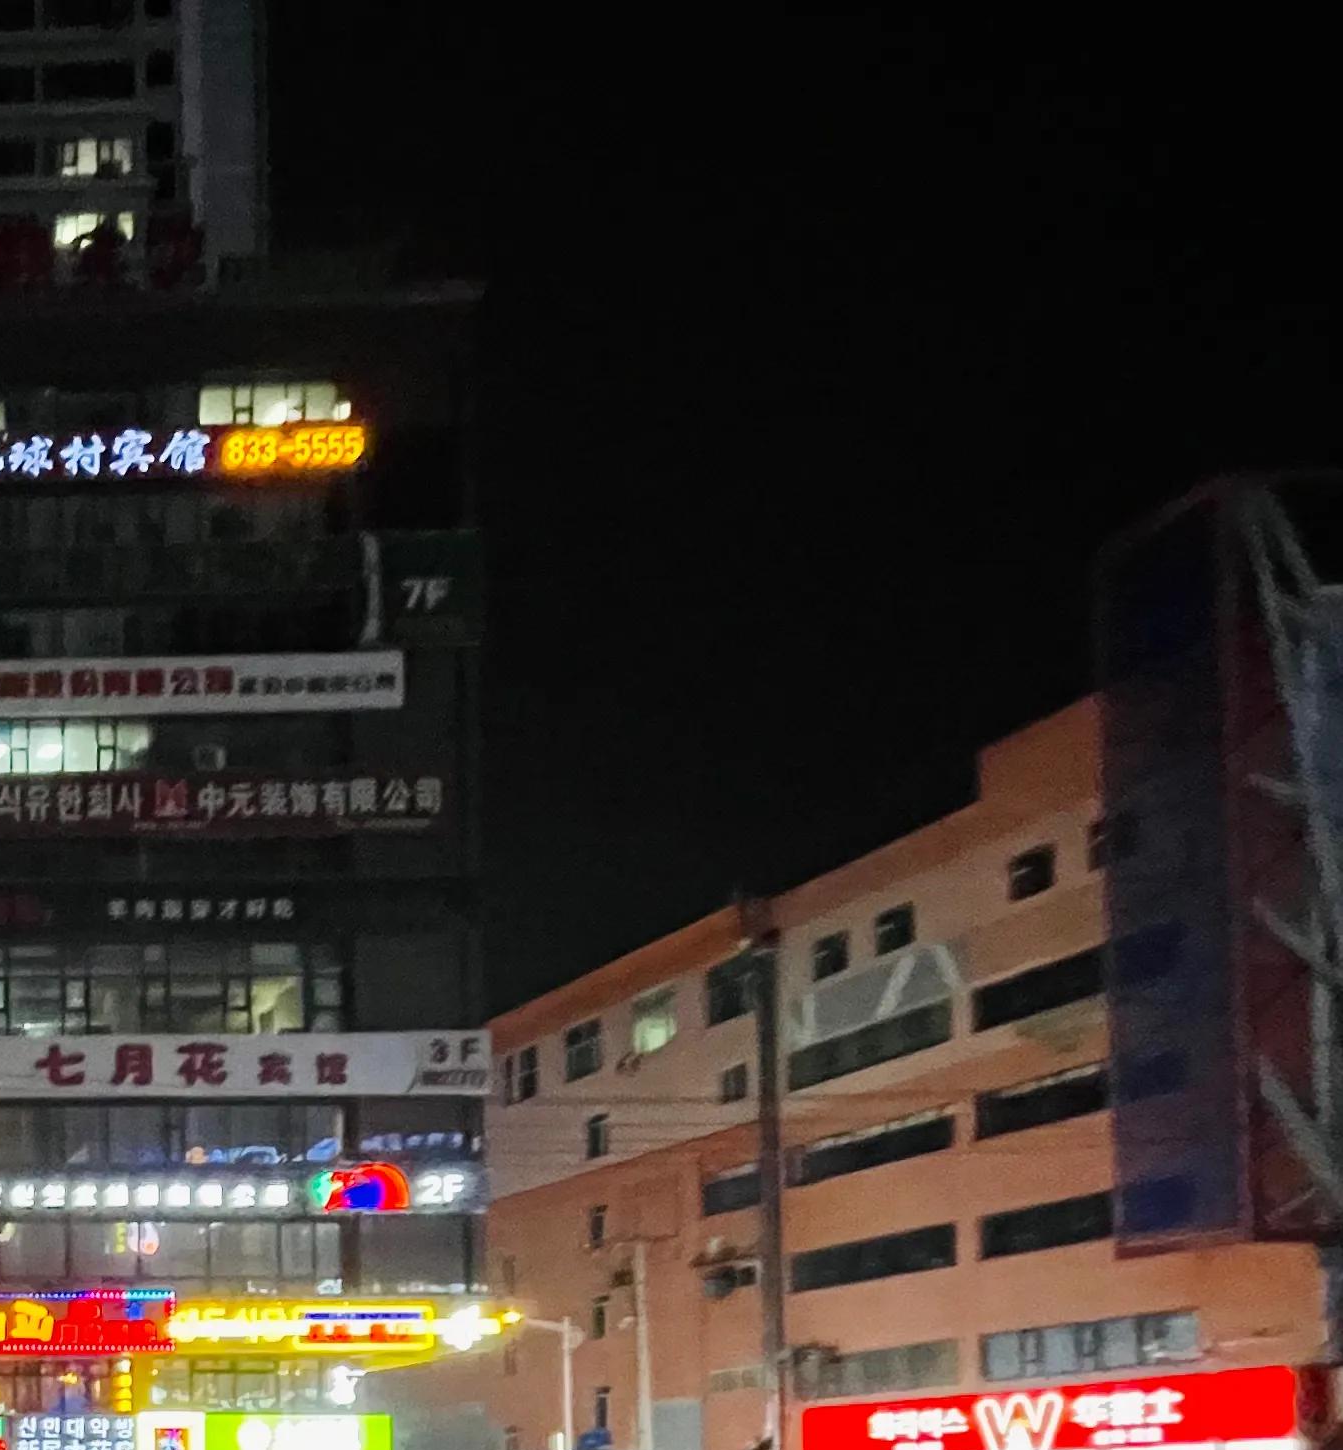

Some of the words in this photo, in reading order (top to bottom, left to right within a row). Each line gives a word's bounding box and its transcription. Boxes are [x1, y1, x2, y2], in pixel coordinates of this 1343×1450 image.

[223, 424, 364, 468] 833-5555
[33, 1043, 348, 1087] 七月花宾馆
[415, 1173, 465, 1205] 2F
[17, 1416, 134, 1440] 신민대약방
